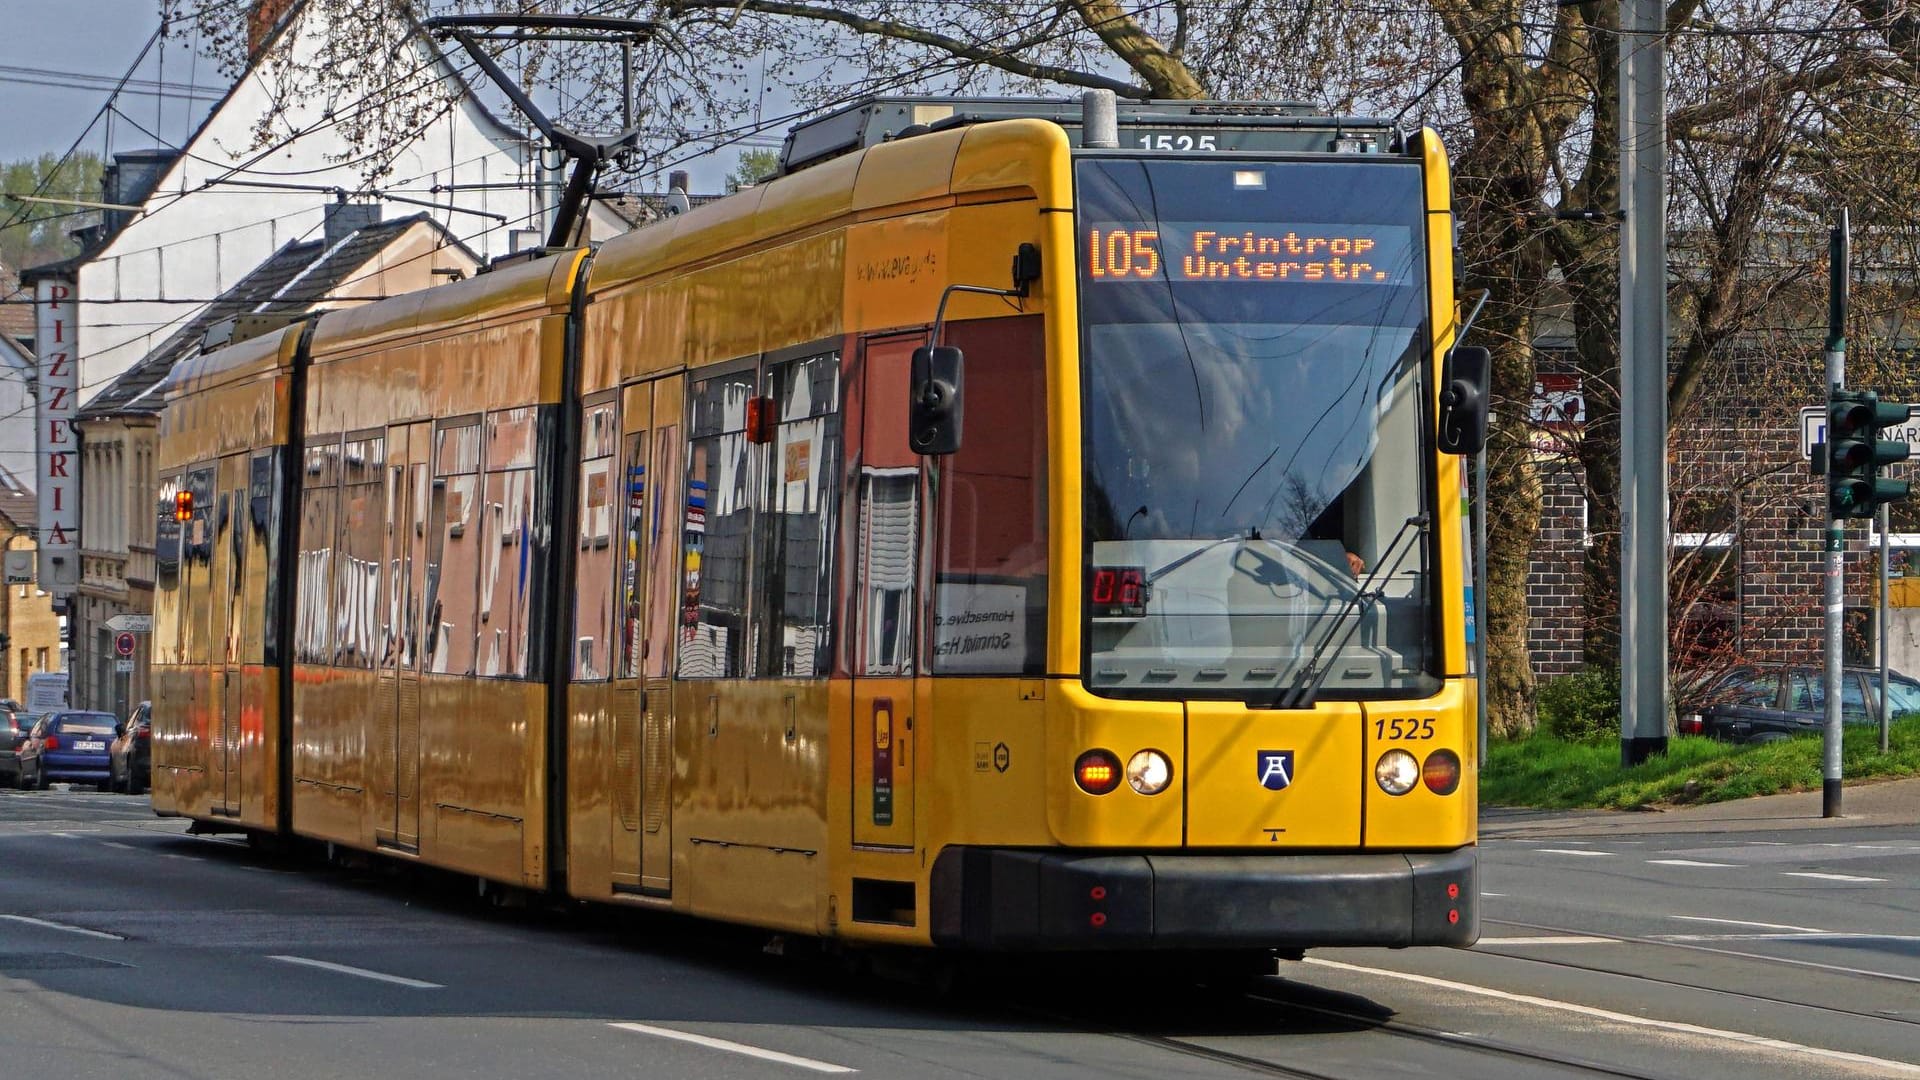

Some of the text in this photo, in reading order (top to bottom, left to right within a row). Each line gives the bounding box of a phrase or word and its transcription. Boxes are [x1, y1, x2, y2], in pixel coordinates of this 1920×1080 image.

[1140, 134, 1216, 152] 1525
[1194, 231, 1375, 254] Frintrop
[1184, 255, 1386, 279] Unterstr.
[47, 285, 70, 545] PIZZERIA
[1833, 539, 1840, 548] 2
[1376, 718, 1436, 741] 1525
